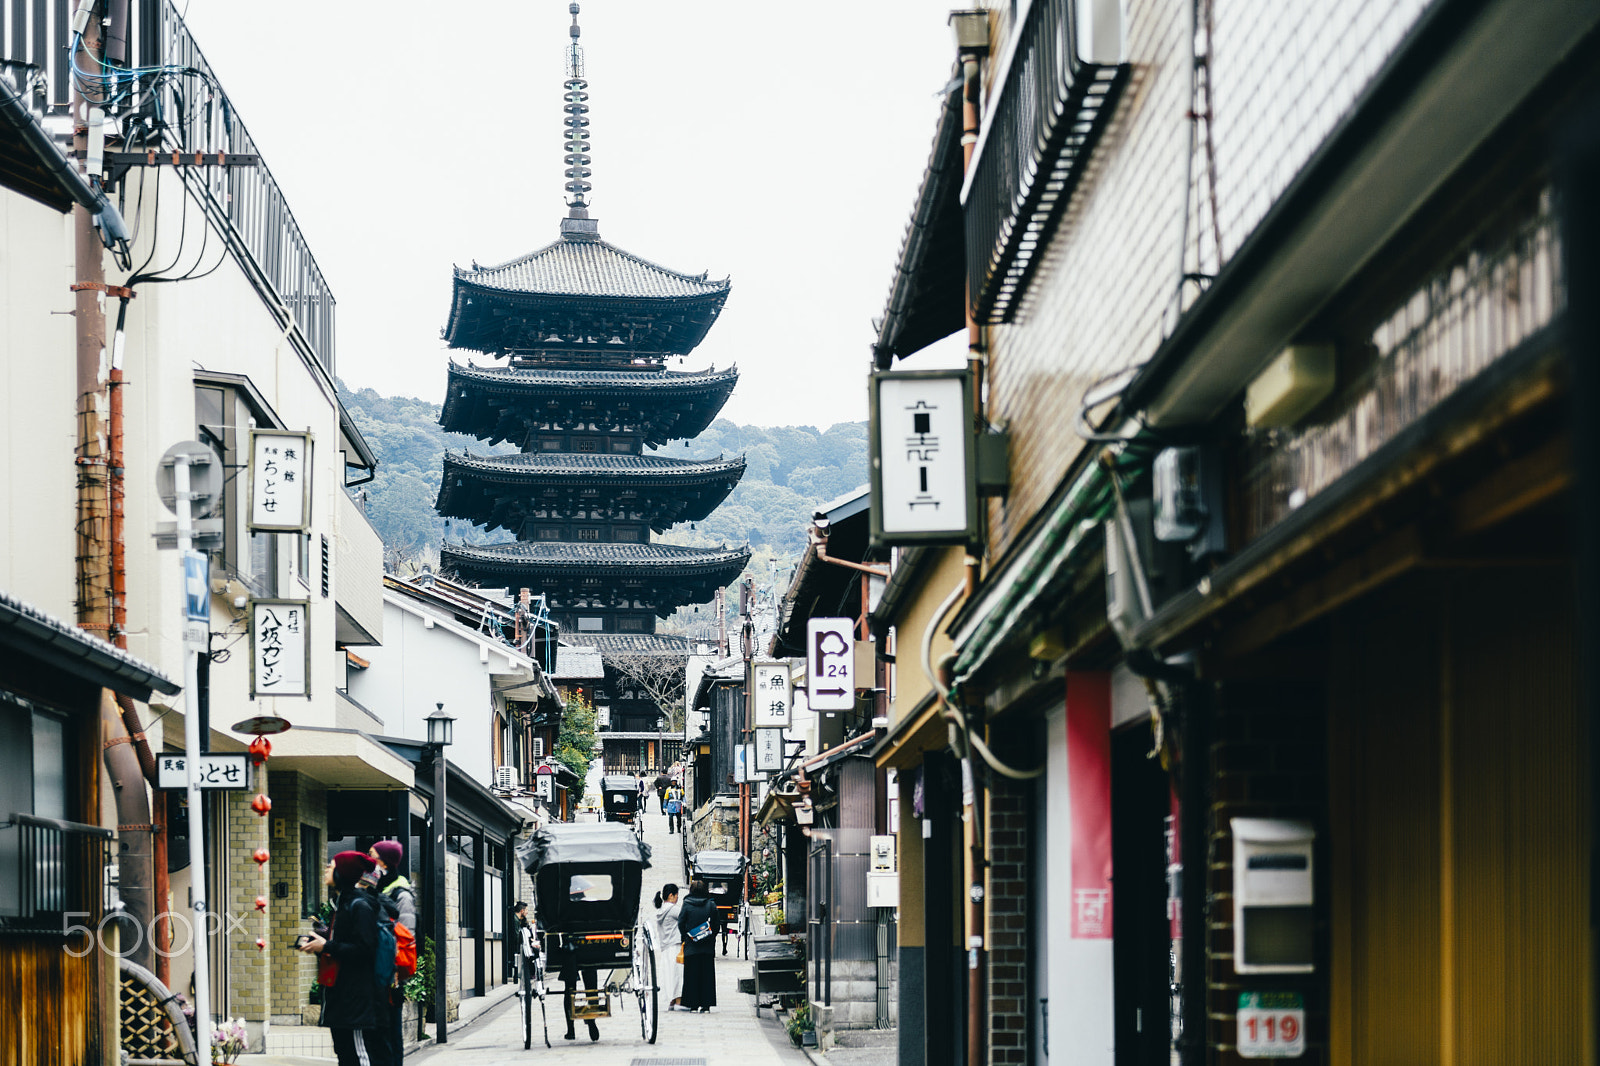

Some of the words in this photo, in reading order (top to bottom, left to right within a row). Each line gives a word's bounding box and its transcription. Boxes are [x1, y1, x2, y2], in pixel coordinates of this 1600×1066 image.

[262, 459, 278, 513] ちとせ
[827, 664, 848, 678] 24
[164, 759, 186, 771] 民宿
[200, 763, 241, 783] とせ
[1244, 1014, 1300, 1043] 119
